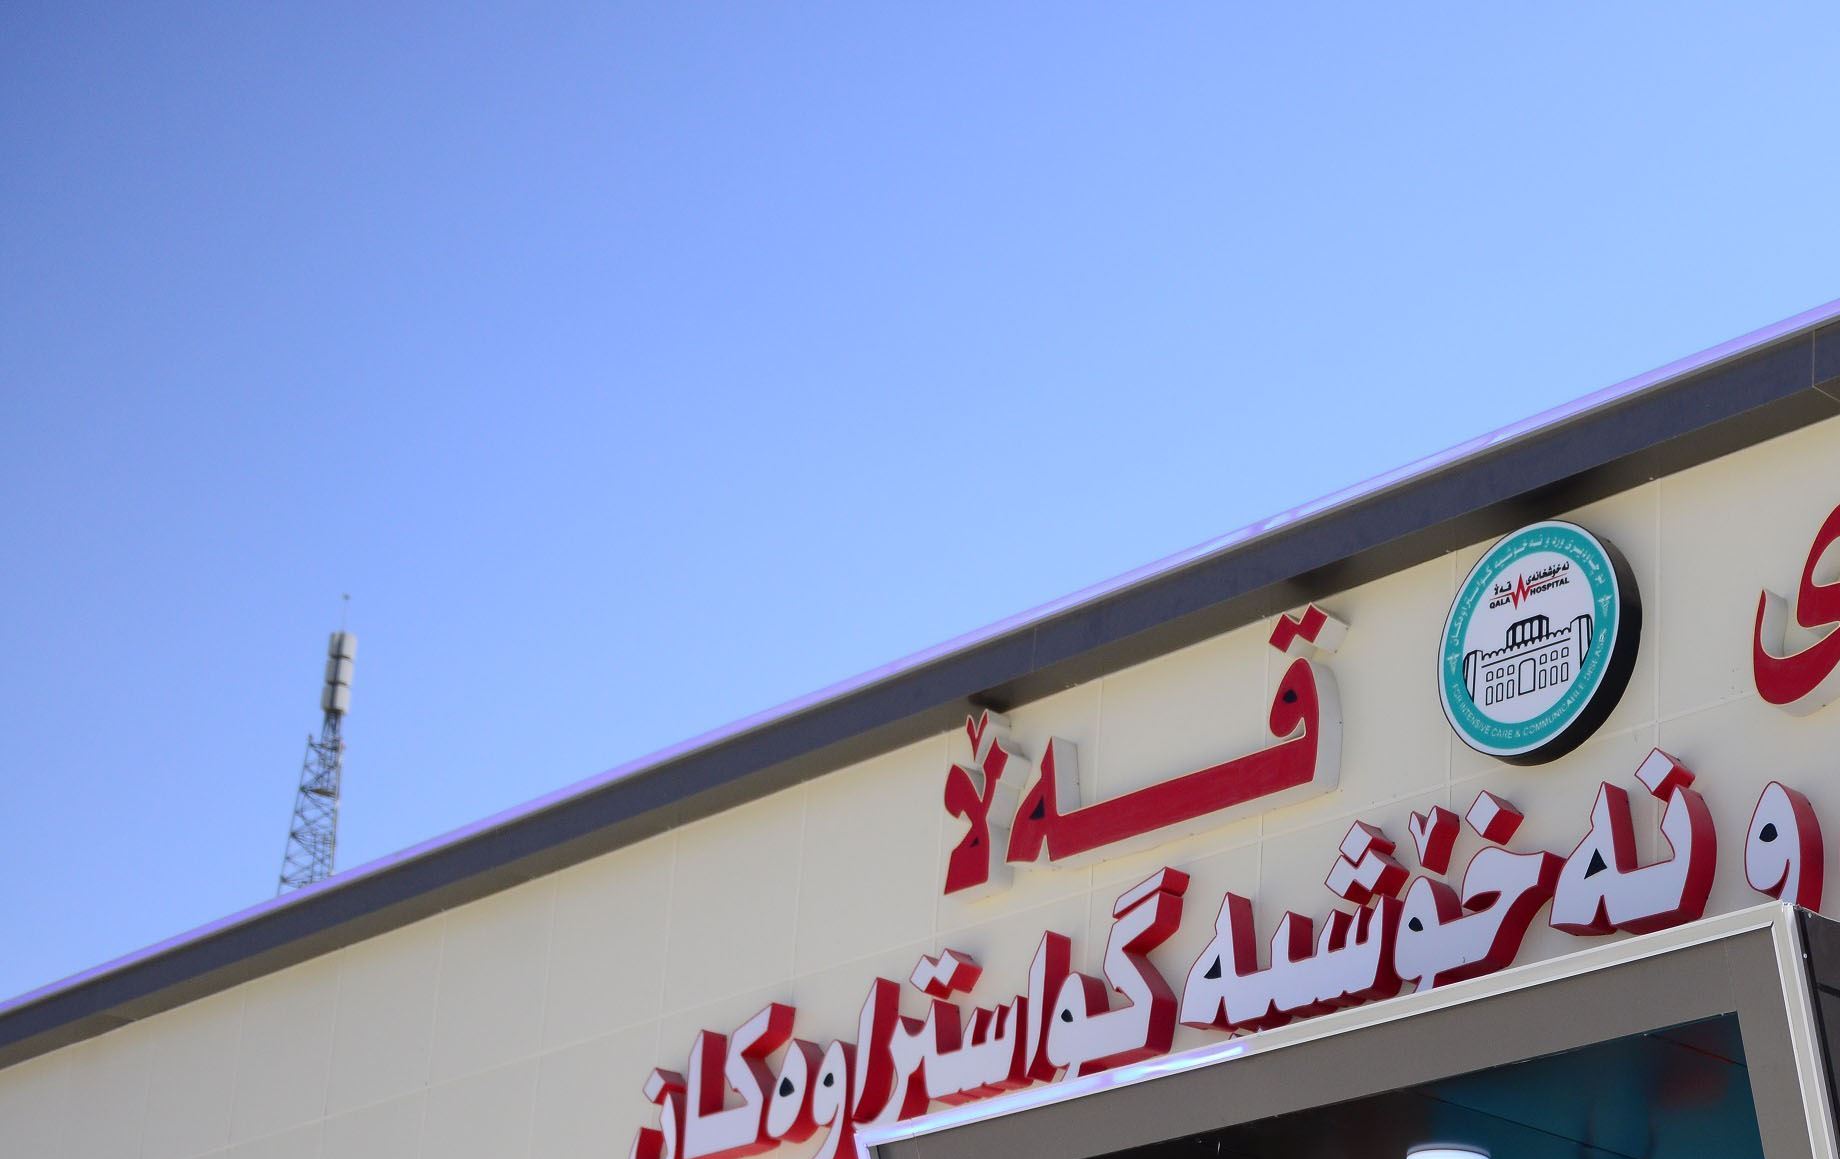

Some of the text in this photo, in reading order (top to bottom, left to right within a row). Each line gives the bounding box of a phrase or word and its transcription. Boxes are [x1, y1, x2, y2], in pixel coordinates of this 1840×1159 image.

[1489, 577, 1570, 609] QALA HOSPITAL
[1460, 702, 1491, 735] INTENSIVE
[1491, 727, 1513, 738] CARE
